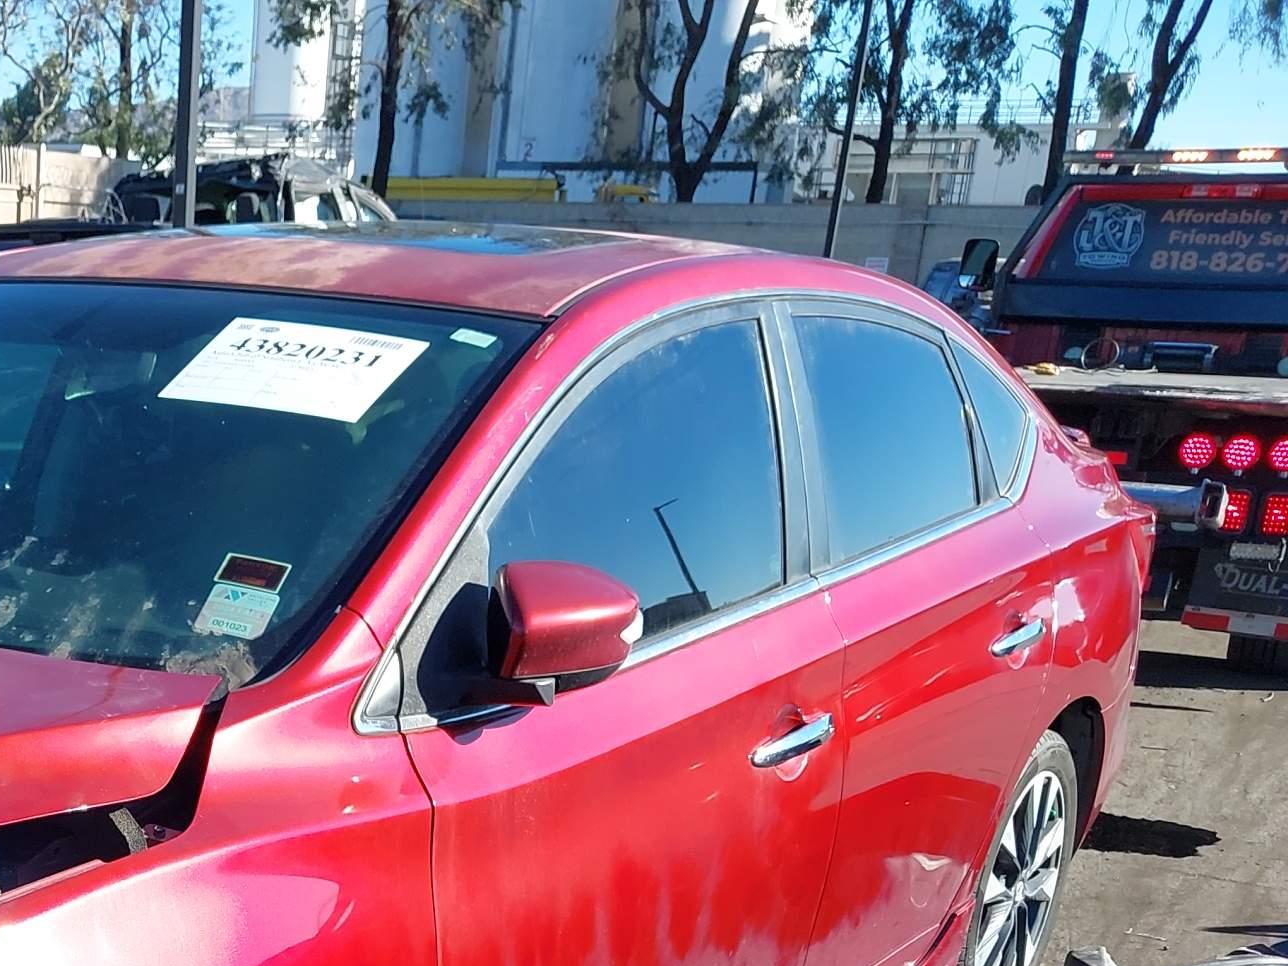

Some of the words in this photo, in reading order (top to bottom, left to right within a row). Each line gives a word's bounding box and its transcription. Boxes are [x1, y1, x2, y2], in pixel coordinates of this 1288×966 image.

[1160, 209, 1273, 224] Affordable
[1168, 228, 1254, 248] Friendly
[229, 337, 383, 368] 43820231
[212, 619, 248, 632] 001023
